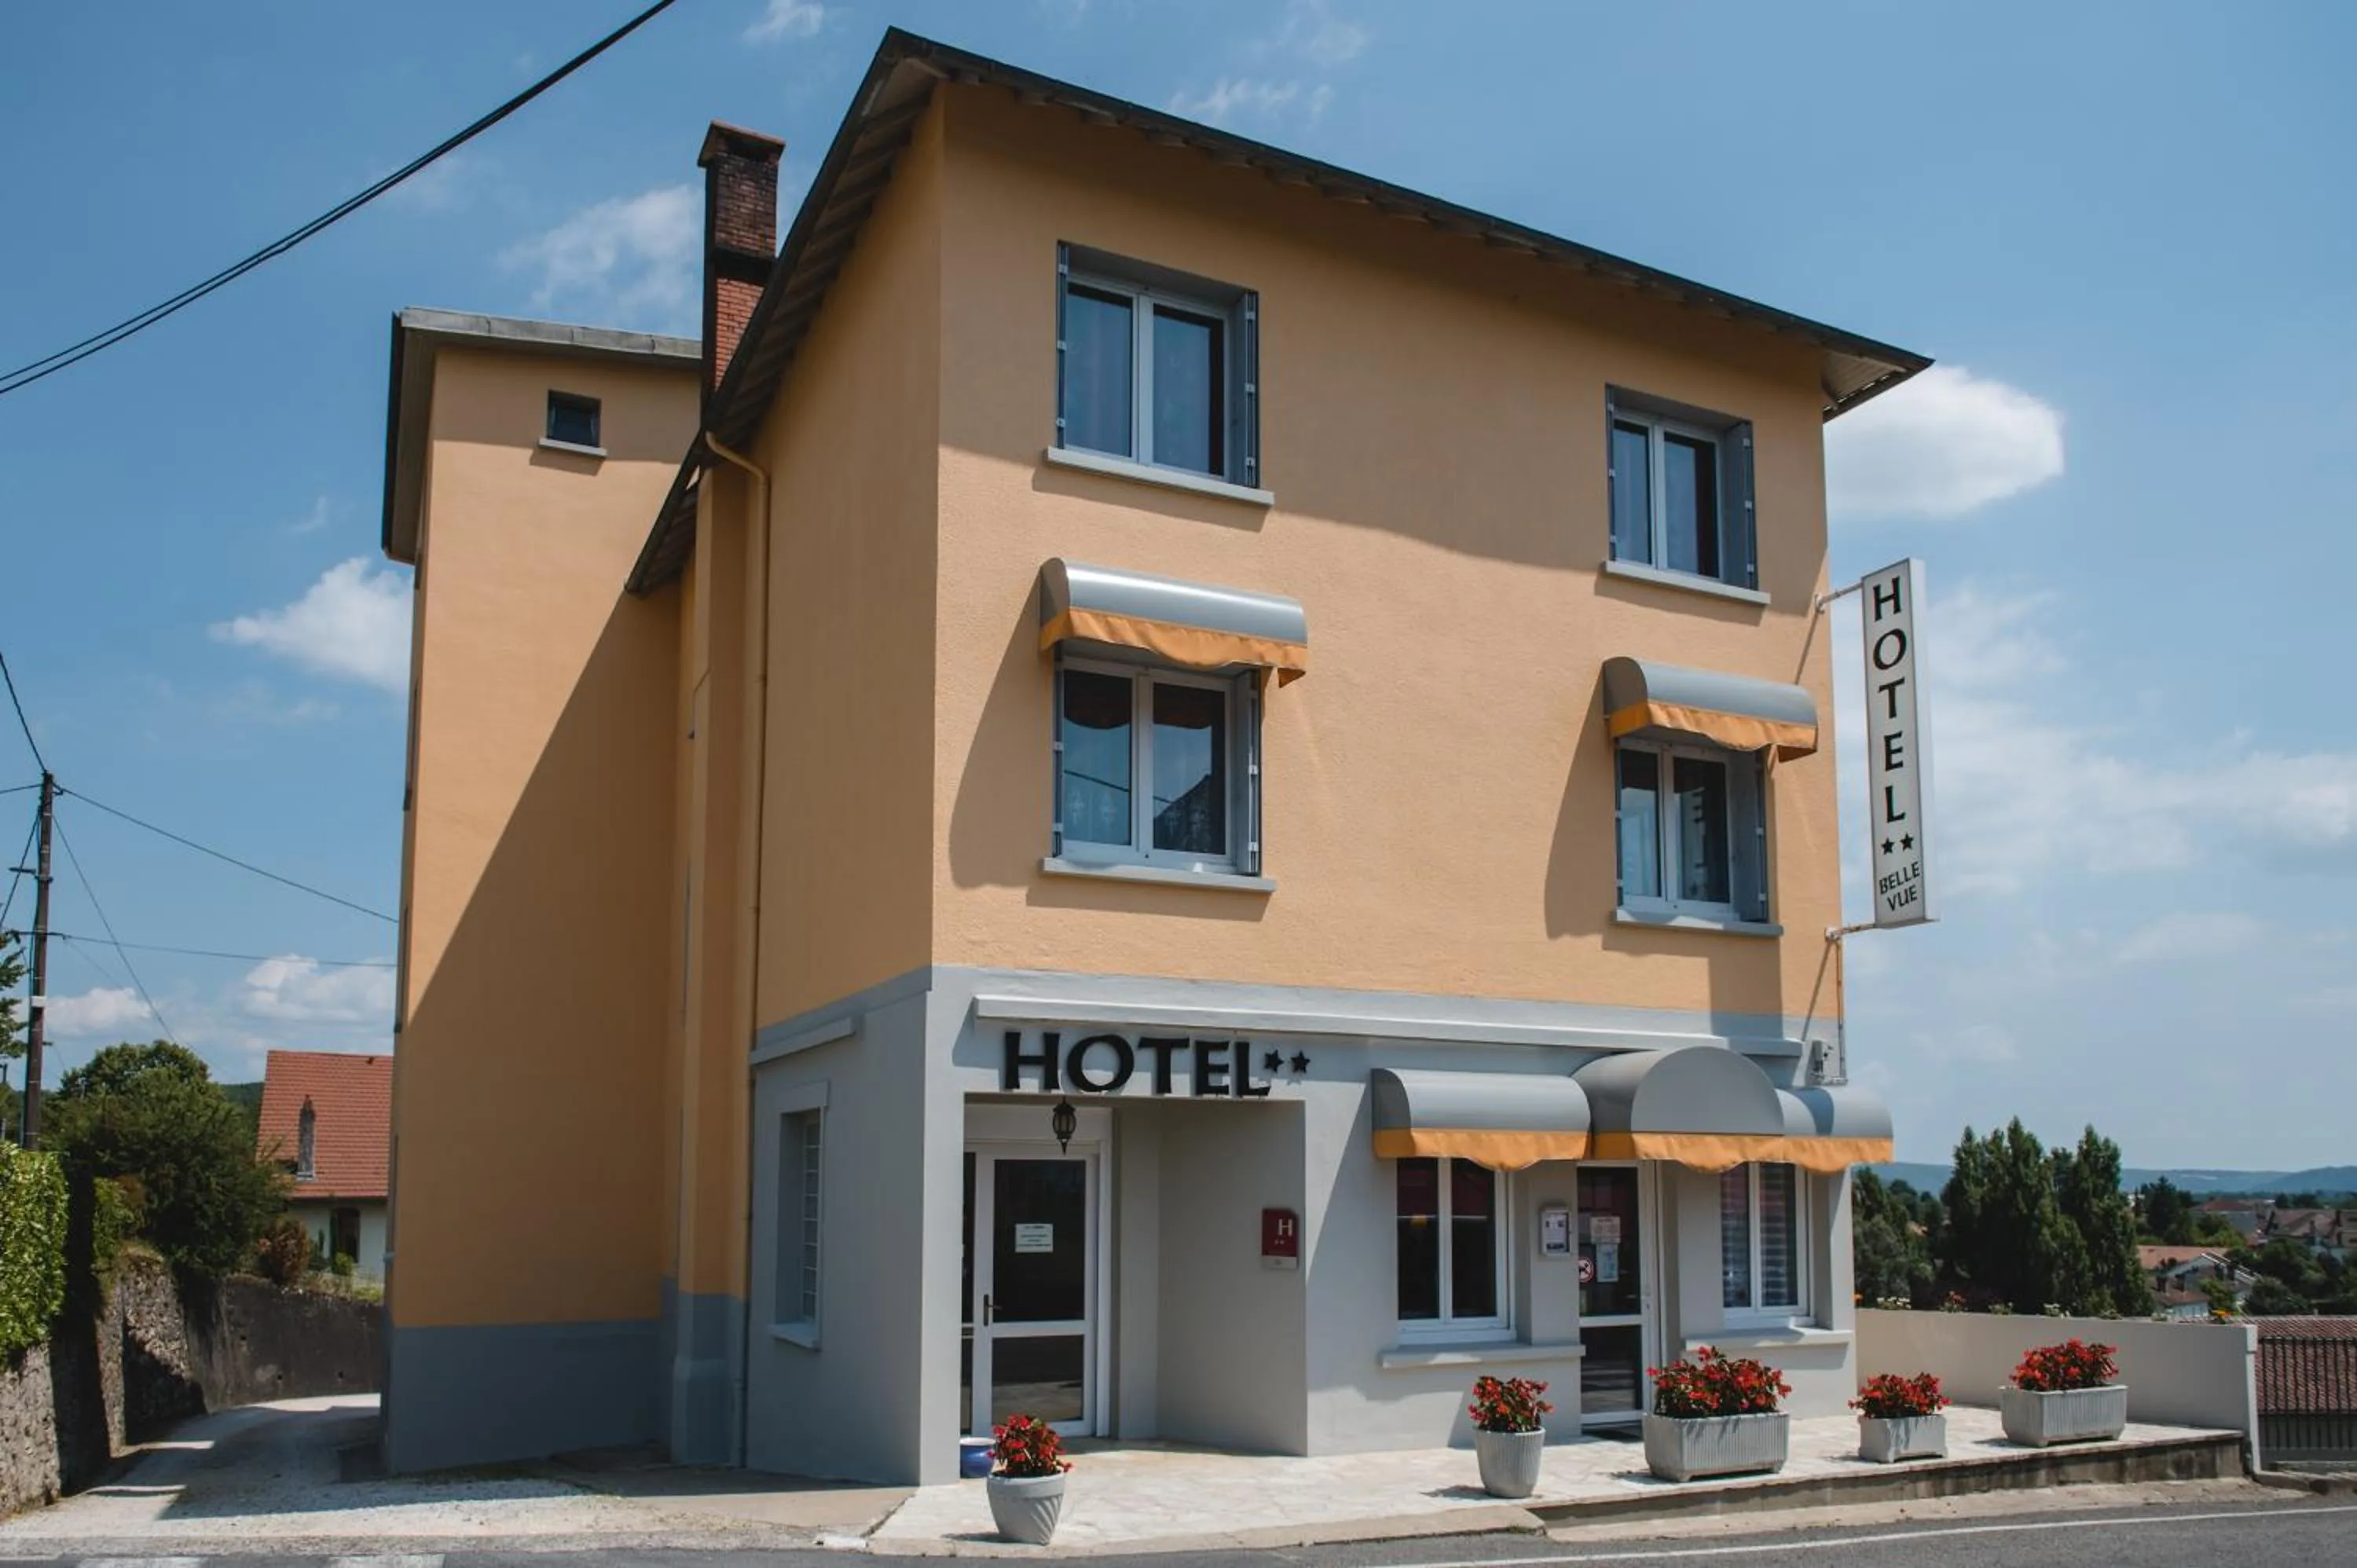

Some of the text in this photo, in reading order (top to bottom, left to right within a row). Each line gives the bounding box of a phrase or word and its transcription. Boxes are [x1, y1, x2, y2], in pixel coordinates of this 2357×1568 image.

[1872, 577, 1908, 824] HOTEL
[1879, 861, 1920, 896] BELLE
[1886, 885, 1918, 912] VUE
[1004, 1031, 1271, 1097] HOTEL
[1278, 1218, 1292, 1236] H
